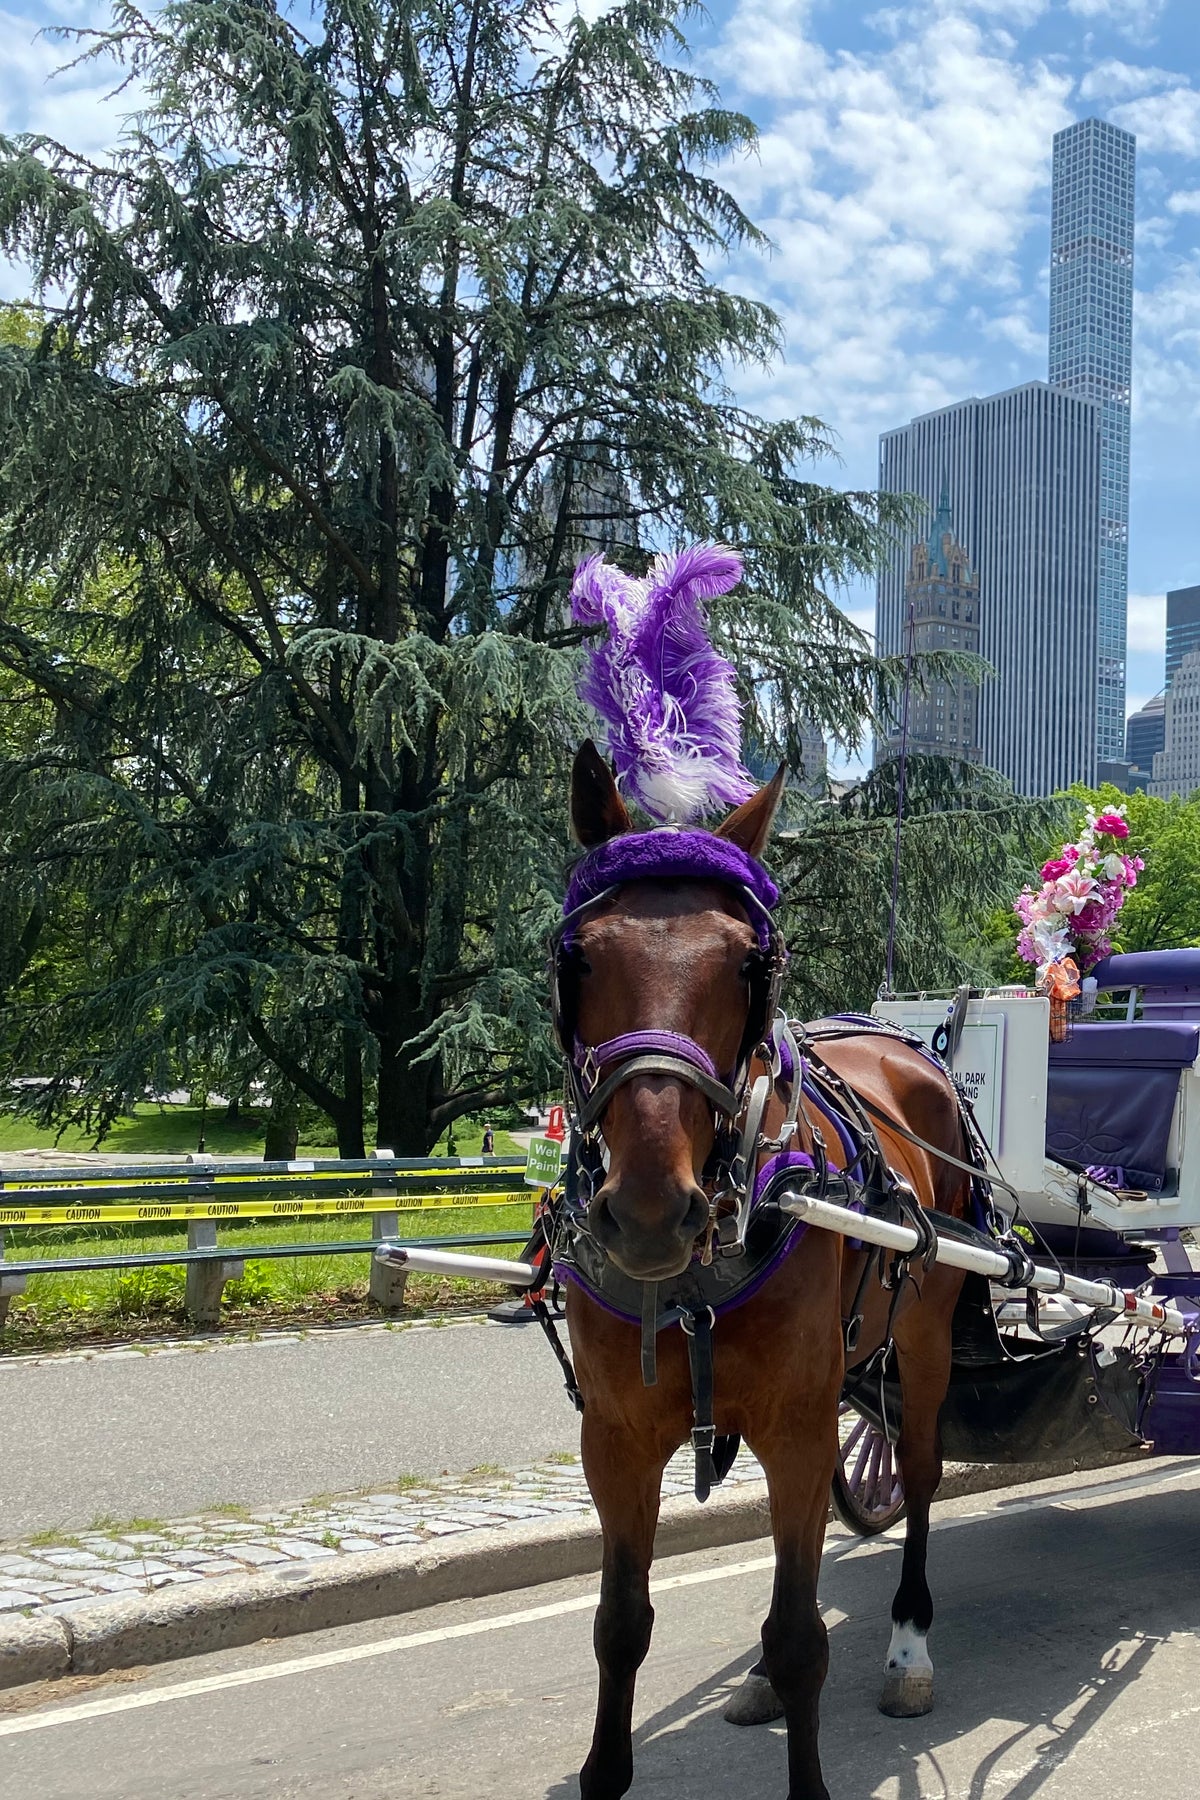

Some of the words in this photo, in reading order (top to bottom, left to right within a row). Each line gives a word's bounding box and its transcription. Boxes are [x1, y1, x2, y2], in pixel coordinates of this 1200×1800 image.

[965, 1072, 986, 1085] PARK
[535, 1143, 557, 1158] Wet
[529, 1157, 558, 1173] Paint
[66, 1209, 100, 1221] CAUTION
[138, 1207, 172, 1218] CAUTION
[207, 1205, 239, 1216] CAUTION
[273, 1202, 303, 1213] CAUTION
[335, 1200, 365, 1210] CAUTION
[395, 1198, 423, 1208] CAUTION
[452, 1196, 478, 1205] CAUTION
[506, 1193, 532, 1202] CAUTION
